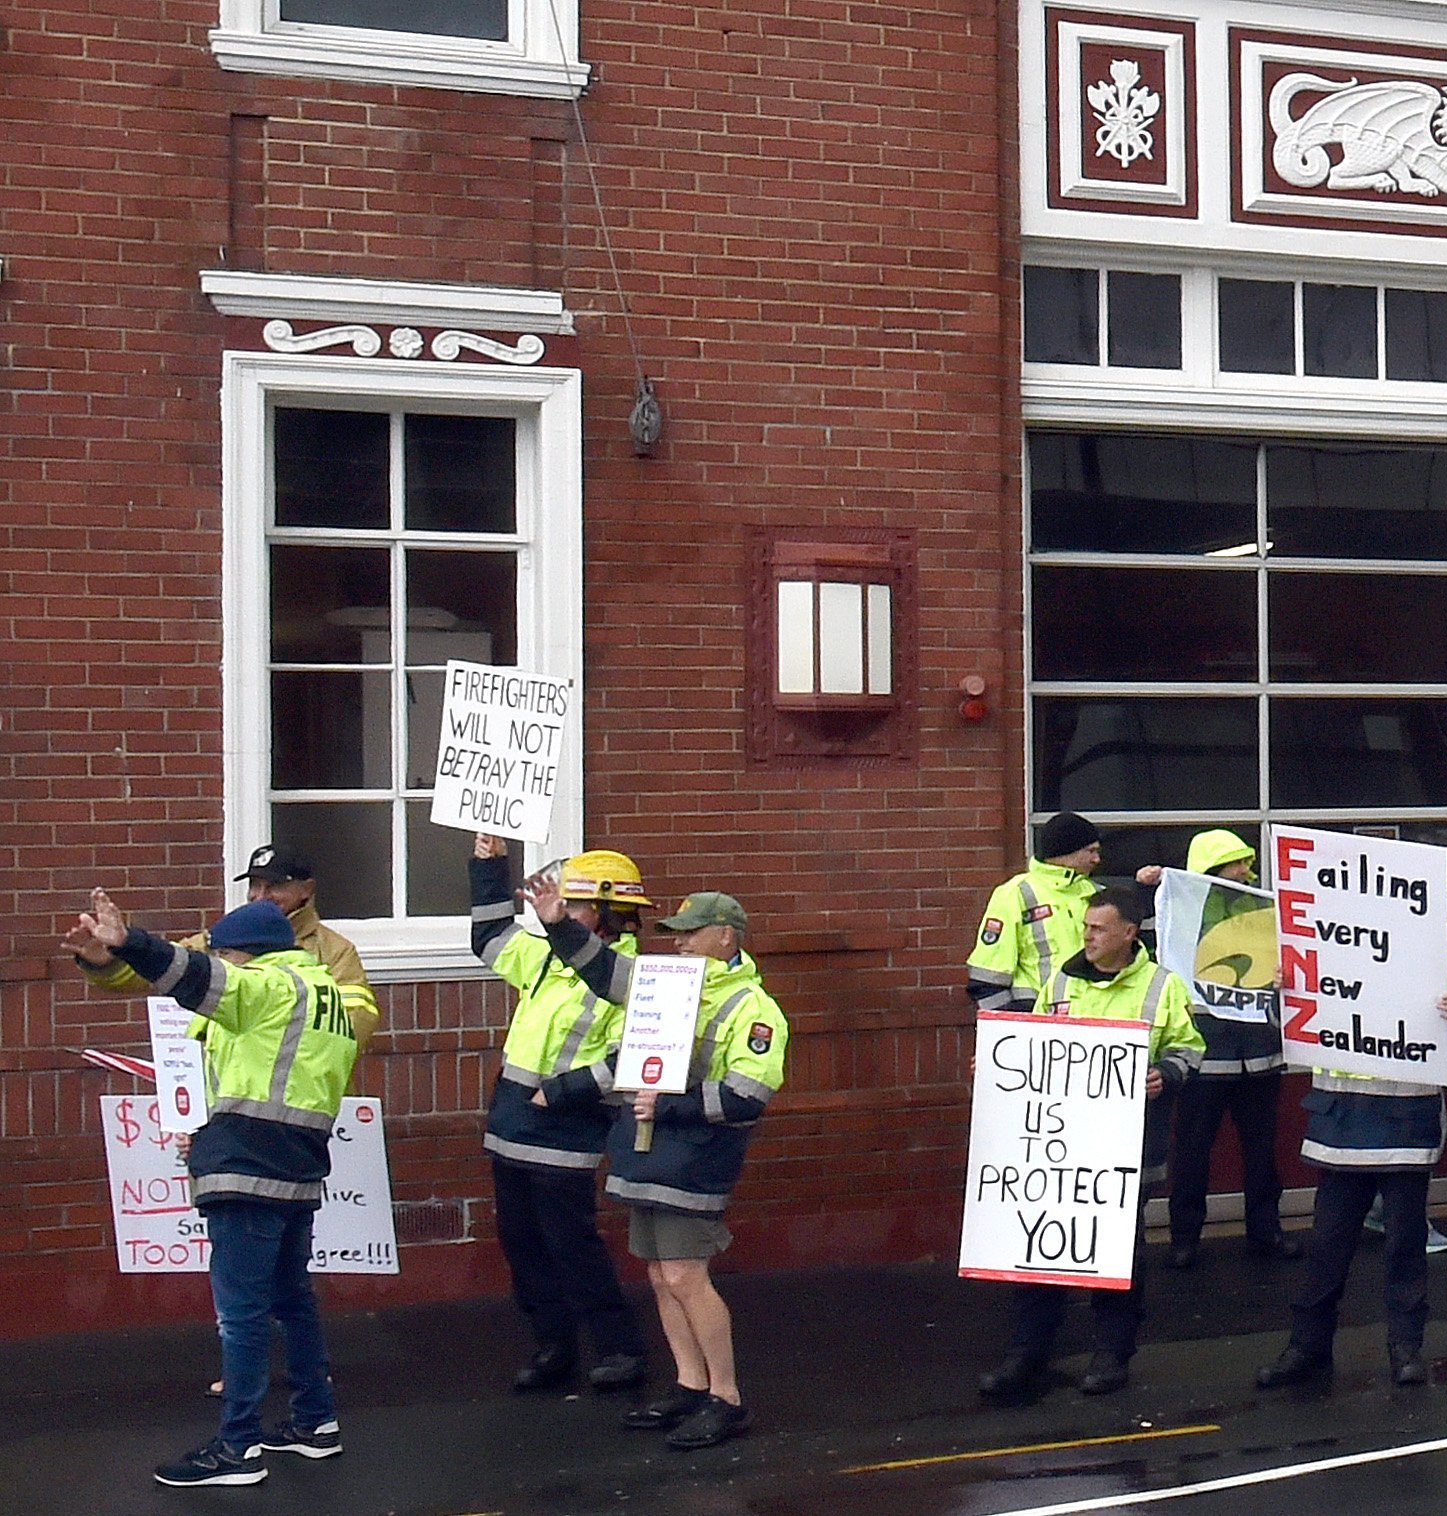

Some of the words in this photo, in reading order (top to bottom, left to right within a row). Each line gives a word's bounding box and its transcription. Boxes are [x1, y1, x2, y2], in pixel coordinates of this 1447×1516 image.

[452, 669, 568, 716] FIREFIGHTERS
[450, 708, 492, 745] WILL
[508, 719, 560, 757] NOT
[440, 746, 516, 788] BETRAY
[521, 760, 556, 797] THE
[459, 788, 524, 829] PUBLIC
[1277, 836, 1427, 916] Failing
[1278, 888, 1390, 963] Every
[1281, 944, 1363, 1001] New
[1283, 996, 1437, 1063] Zealander
[993, 1035, 1149, 1100] SUPPORT
[1026, 1100, 1065, 1134] US
[1020, 1137, 1067, 1163] TO
[977, 1165, 1138, 1208] PROTECT
[125, 1239, 212, 1266] TOOT
[1017, 1210, 1098, 1264] YOU
